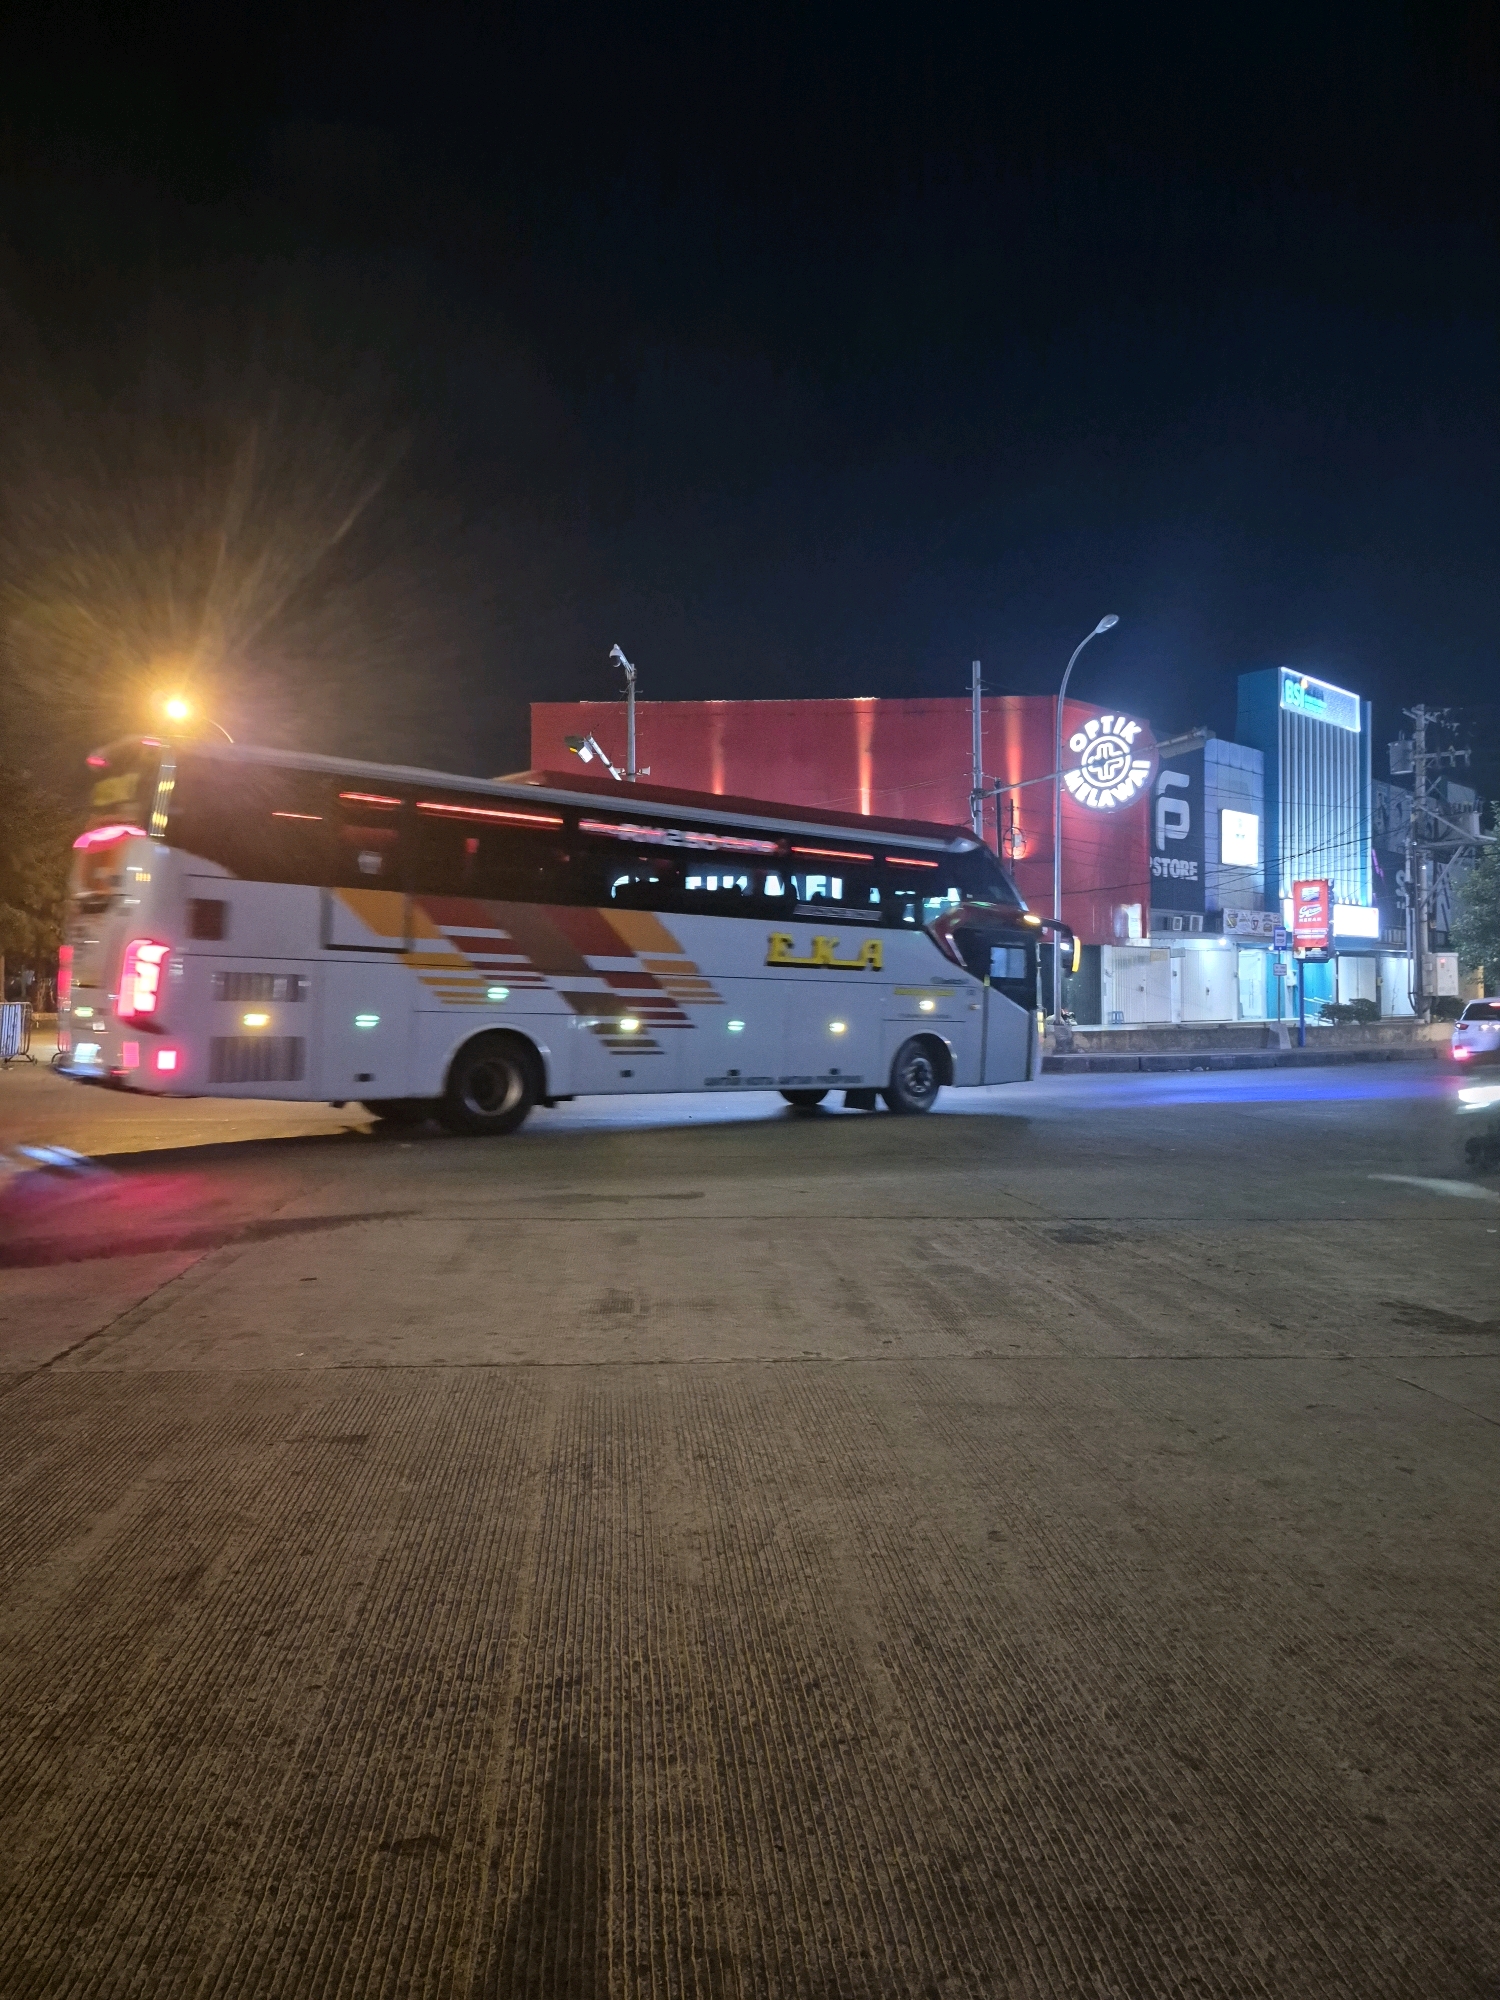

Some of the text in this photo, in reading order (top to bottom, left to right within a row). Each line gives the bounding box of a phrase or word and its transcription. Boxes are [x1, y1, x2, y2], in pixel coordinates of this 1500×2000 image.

[1285, 679, 1305, 708] BSI
[1070, 715, 1142, 753] OPTIK
[1063, 759, 1151, 809] MELAWAI
[766, 931, 883, 972] EKA
